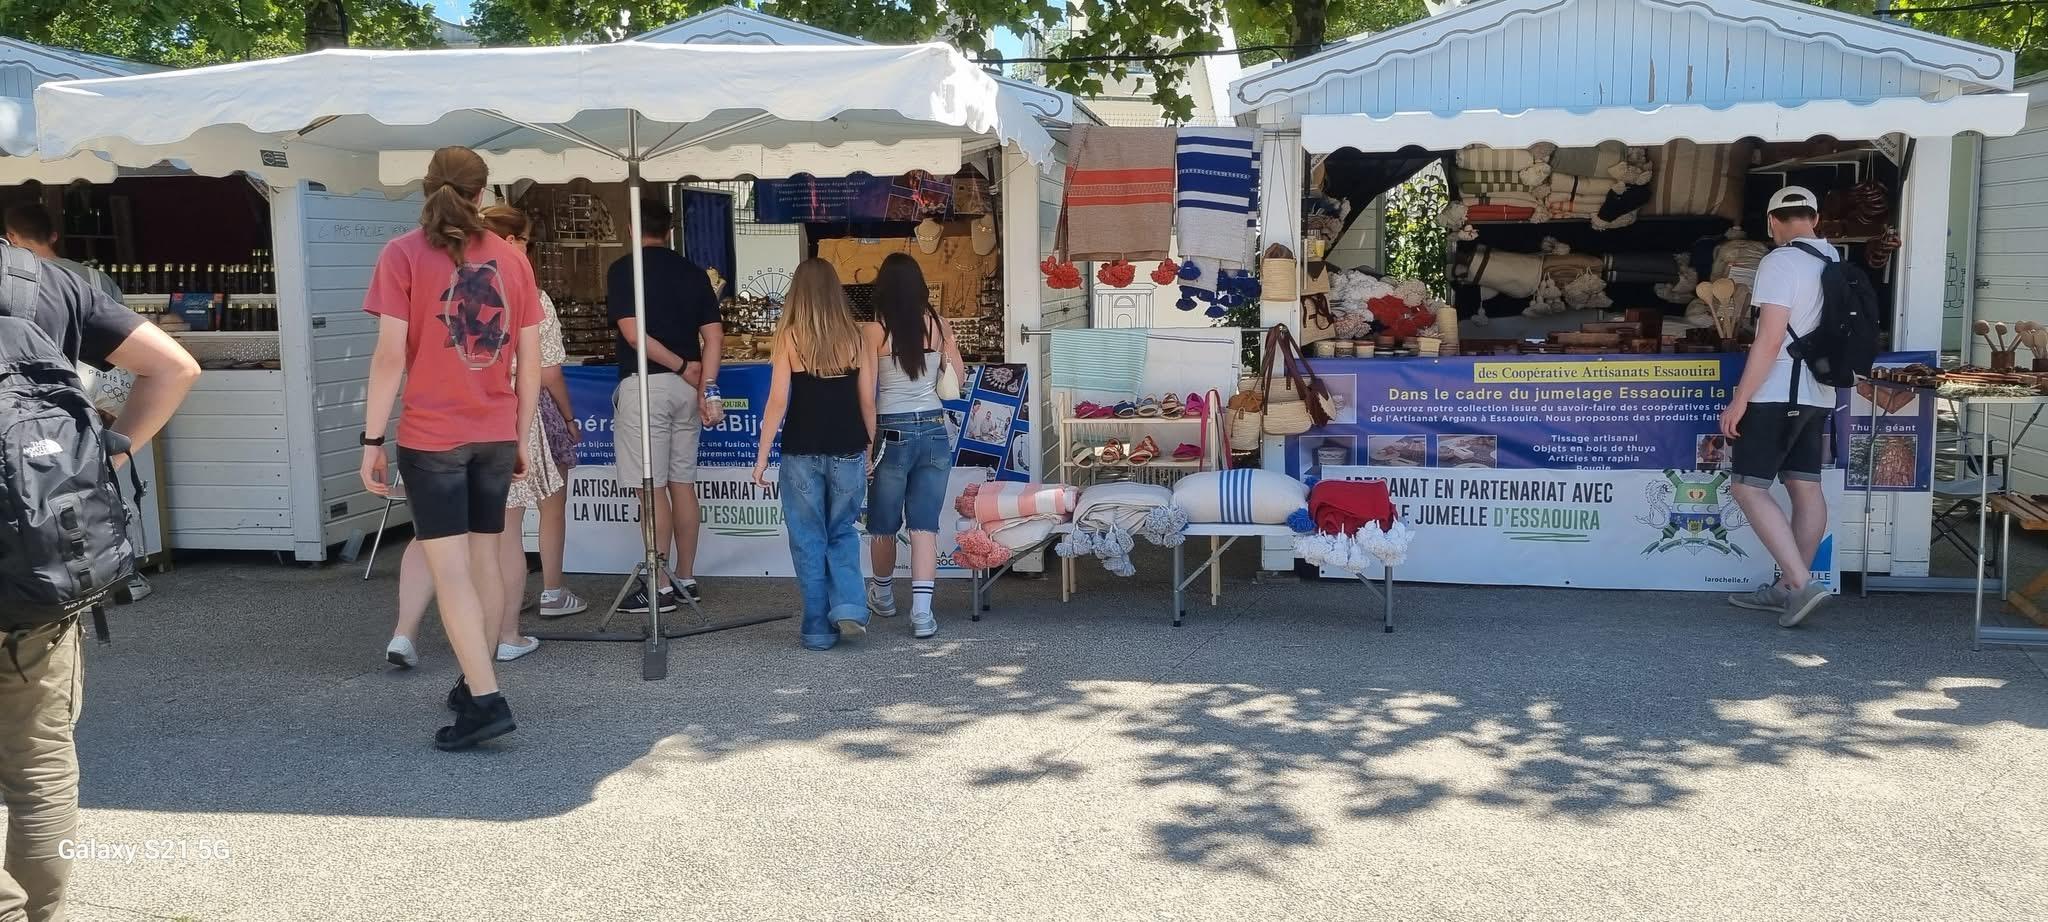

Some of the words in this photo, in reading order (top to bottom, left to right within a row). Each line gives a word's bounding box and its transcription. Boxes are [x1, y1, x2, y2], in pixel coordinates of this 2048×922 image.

[1478, 367, 1498, 379] des
[1502, 366, 1578, 381] Coopérative
[1582, 366, 1650, 378] Artisanats
[1654, 365, 1716, 377] Essaouira
[88, 369, 118, 383] PARIS
[120, 379, 131, 389] 20
[1389, 388, 1428, 401] Dans
[1435, 388, 1449, 400] le
[1456, 388, 1502, 400] cadre
[1509, 387, 1529, 400] du
[1534, 386, 1612, 402] jumelage
[1619, 386, 1703, 400] Essaouira
[1711, 386, 1725, 398] la
[1372, 404, 1423, 412] Découvrez
[1457, 404, 1508, 412] collection
[1511, 404, 1537, 412] issue
[1541, 404, 1553, 412] du
[1557, 403, 1616, 412] savoir-faire
[1620, 403, 1638, 412] des
[1641, 403, 1710, 413] coopératives
[1714, 403, 1727, 411] du
[1442, 415, 1477, 424] Argana
[1481, 414, 1487, 422] à
[1490, 414, 1542, 422] Essaouira.
[1546, 414, 1571, 422] Nous
[1575, 415, 1629, 423] proposons
[1632, 414, 1650, 422] des
[1654, 414, 1699, 423] produits
[1702, 414, 1720, 422] fait
[1885, 424, 1916, 432] géant
[1551, 434, 1590, 444] Tissage
[1593, 434, 1638, 442] artisanal
[588, 440, 614, 449] bijoux
[725, 440, 750, 448] fusion
[1533, 445, 1567, 453] Objets
[1586, 444, 1607, 452] bois
[1611, 444, 1623, 452] de
[1627, 444, 1656, 454] thuya
[575, 450, 588, 458] yle
[697, 450, 735, 458] ièrement
[738, 450, 756, 458] faits
[1548, 455, 1589, 463] Articles
[1592, 455, 1604, 463] en
[1607, 454, 1640, 464] raphia
[695, 480, 756, 500] TENARIAT
[762, 480, 780, 500] AV
[1434, 479, 1454, 499] EN
[1460, 479, 1566, 501] PARTENARIAT
[1572, 482, 1613, 503] AVEC
[574, 503, 590, 521] LA
[593, 503, 629, 523] VILLE
[1416, 506, 1488, 527] JUMELLE
[1494, 507, 1600, 530] D'ESSAOUIRA
[1704, 576, 1750, 584] larochelle.fr
[64, 600, 84, 610] HOT
